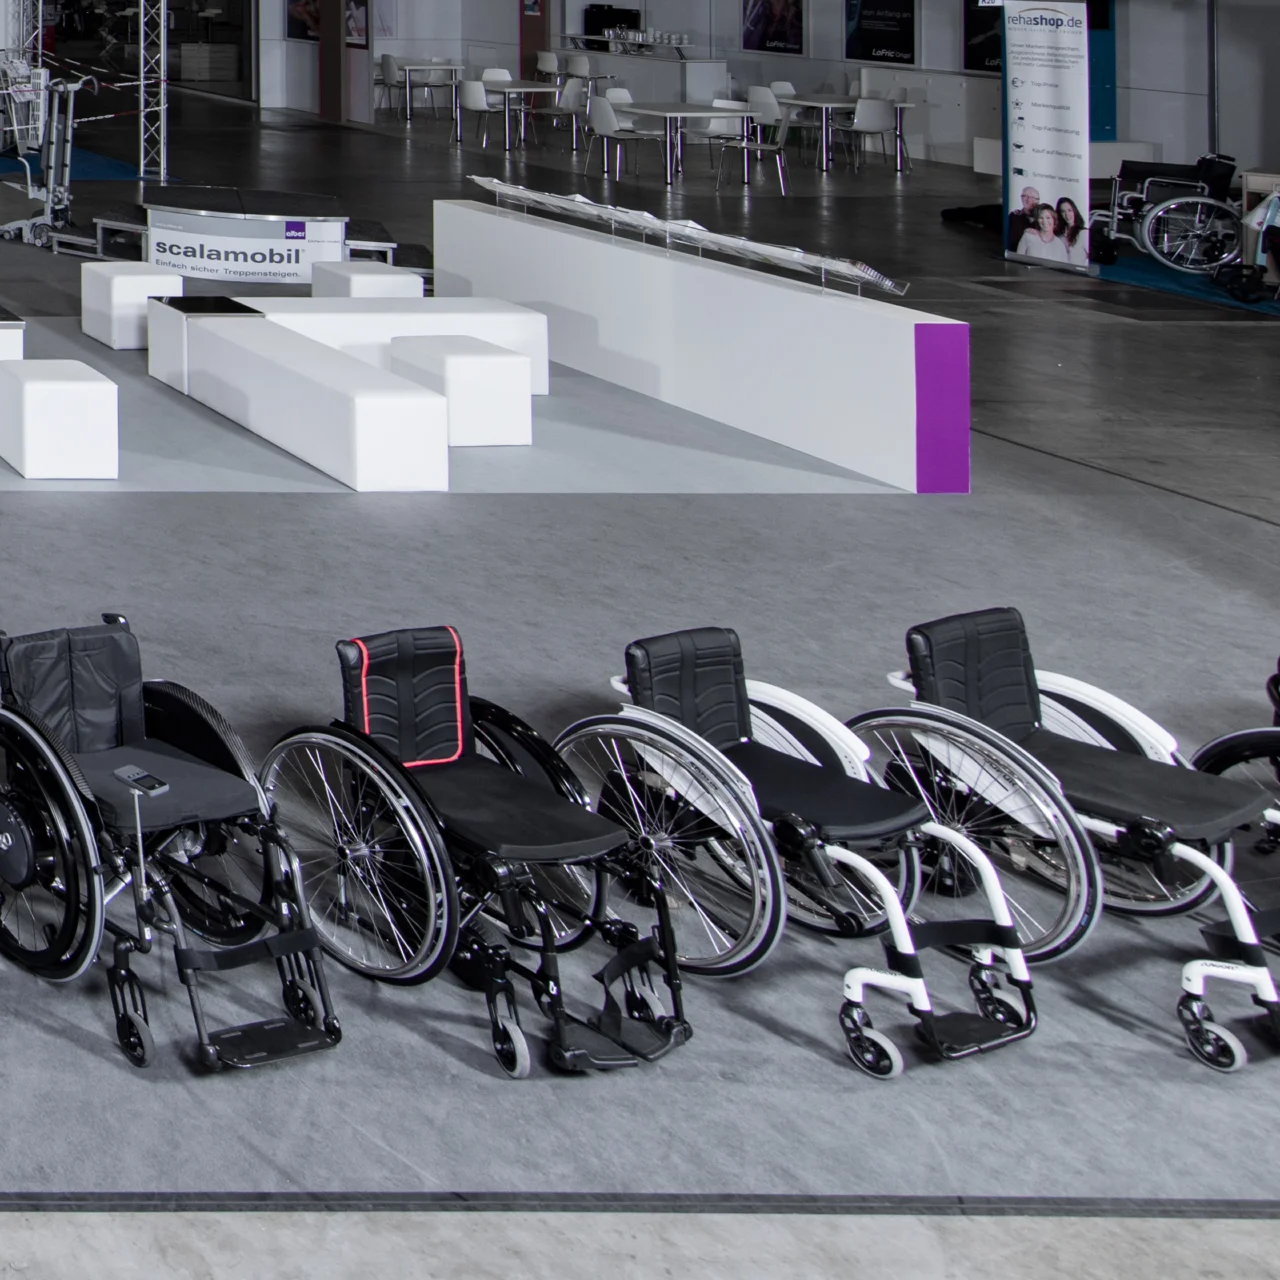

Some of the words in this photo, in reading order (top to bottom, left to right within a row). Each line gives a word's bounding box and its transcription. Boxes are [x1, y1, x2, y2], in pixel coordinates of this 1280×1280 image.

[1007, 14, 1083, 29] rehashop.de
[871, 48, 896, 58] LoFric
[285, 230, 306, 238] alber
[155, 241, 300, 265] scalamobil
[155, 258, 188, 270] Einfach
[190, 265, 220, 274] sicher
[223, 268, 301, 278] Treppensteigen.
